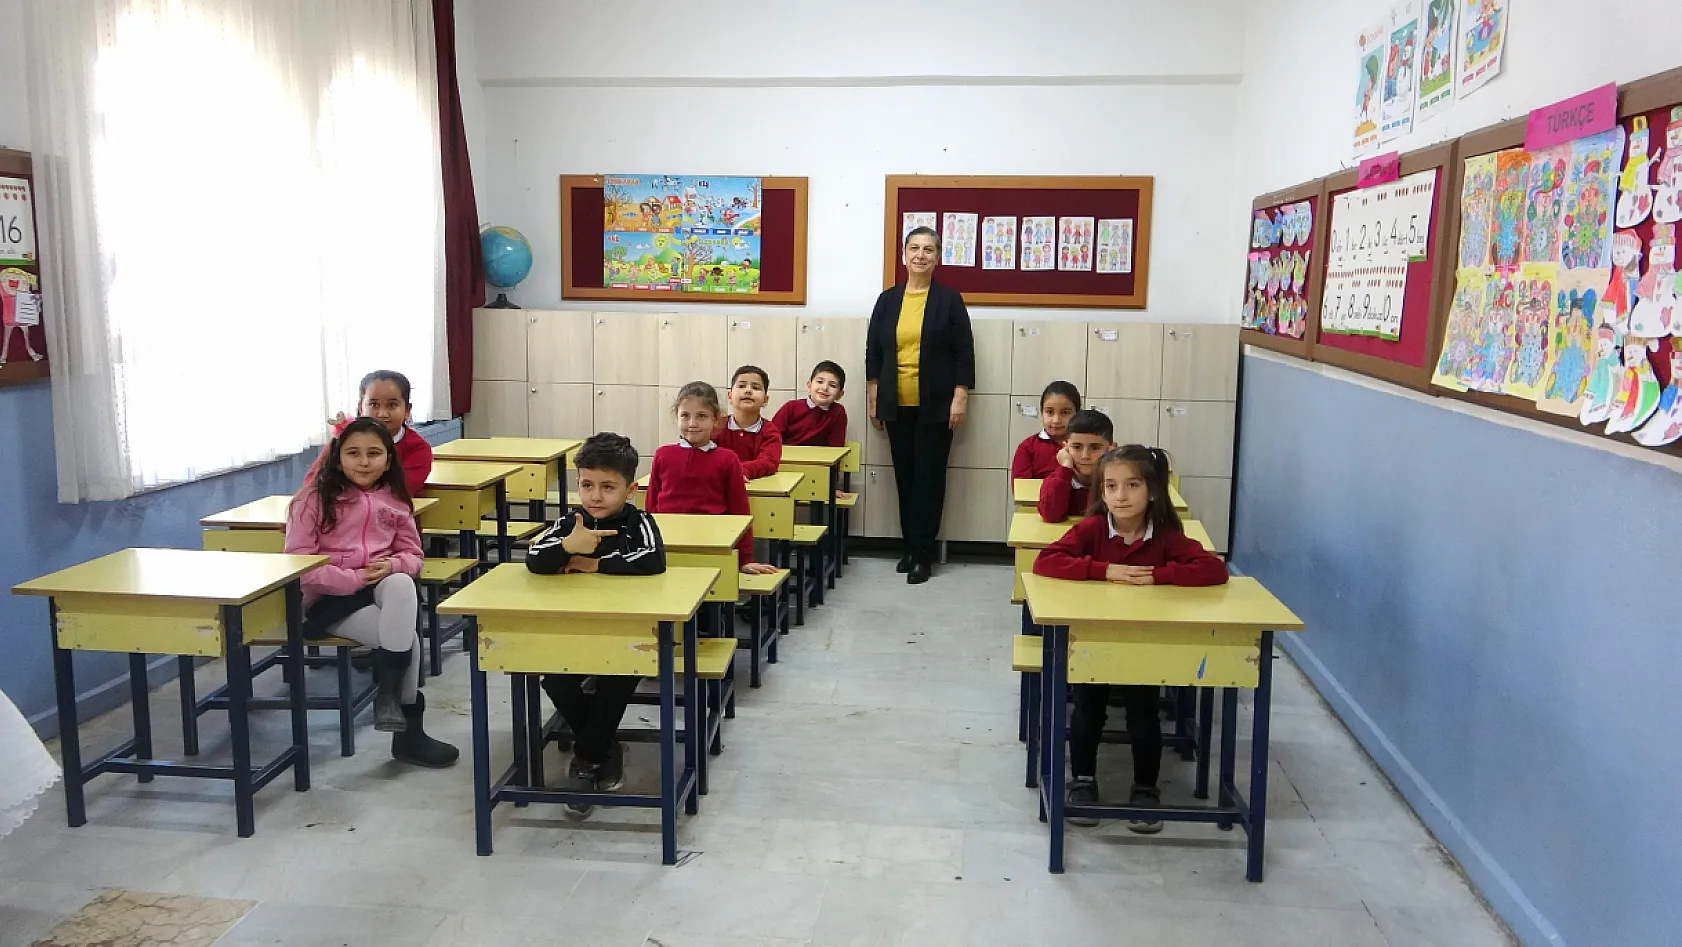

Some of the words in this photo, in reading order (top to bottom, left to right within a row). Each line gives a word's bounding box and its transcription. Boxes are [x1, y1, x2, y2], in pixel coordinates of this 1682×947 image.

[0, 215, 21, 244] 16
[1359, 224, 1367, 250] 2
[1374, 220, 1382, 247] 3
[1390, 217, 1398, 245] 4
[1408, 214, 1418, 244] 5
[1323, 296, 1329, 319] 6
[1335, 296, 1342, 319] 7
[1348, 293, 1356, 319] 8
[1363, 293, 1371, 319] 9
